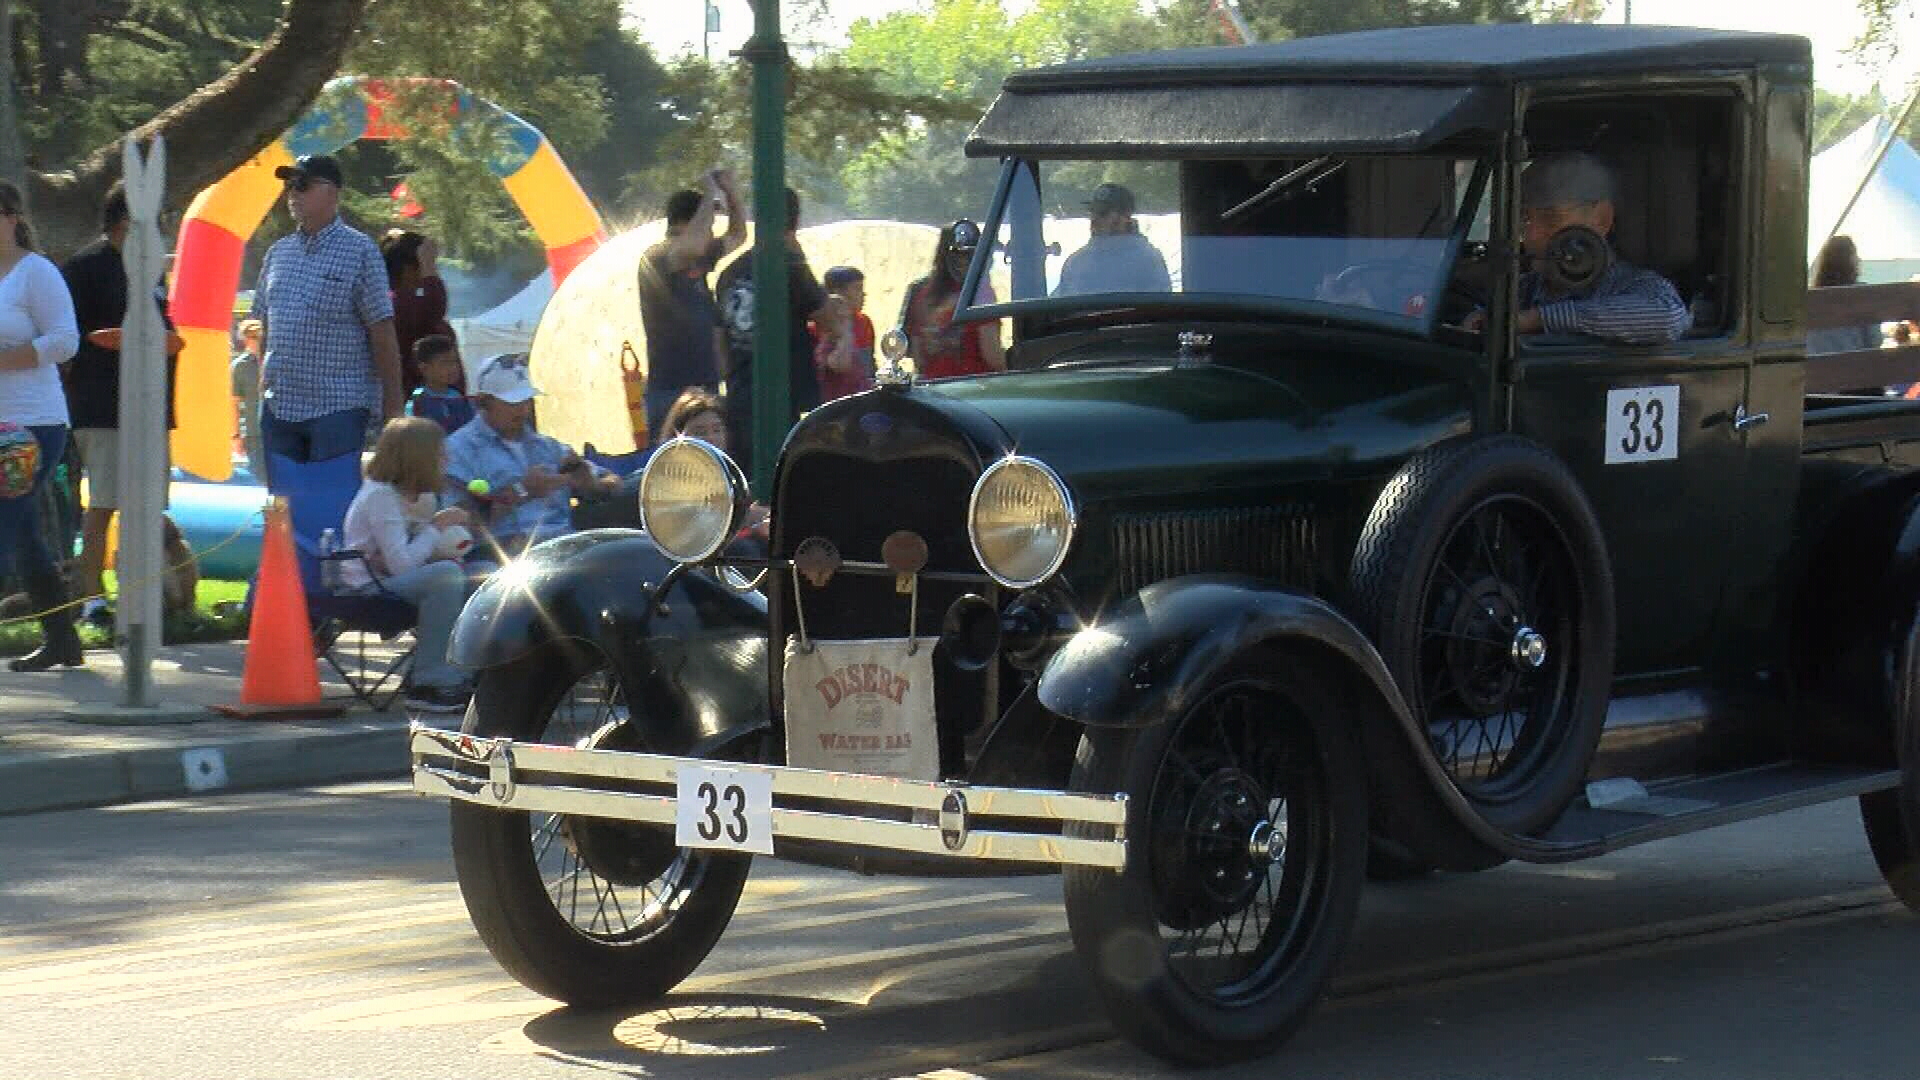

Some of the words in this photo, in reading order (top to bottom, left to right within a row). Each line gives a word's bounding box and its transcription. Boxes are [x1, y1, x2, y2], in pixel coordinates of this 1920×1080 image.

[1622, 399, 1664, 454] 33
[818, 734, 881, 749] WATER
[697, 781, 749, 844] 33
